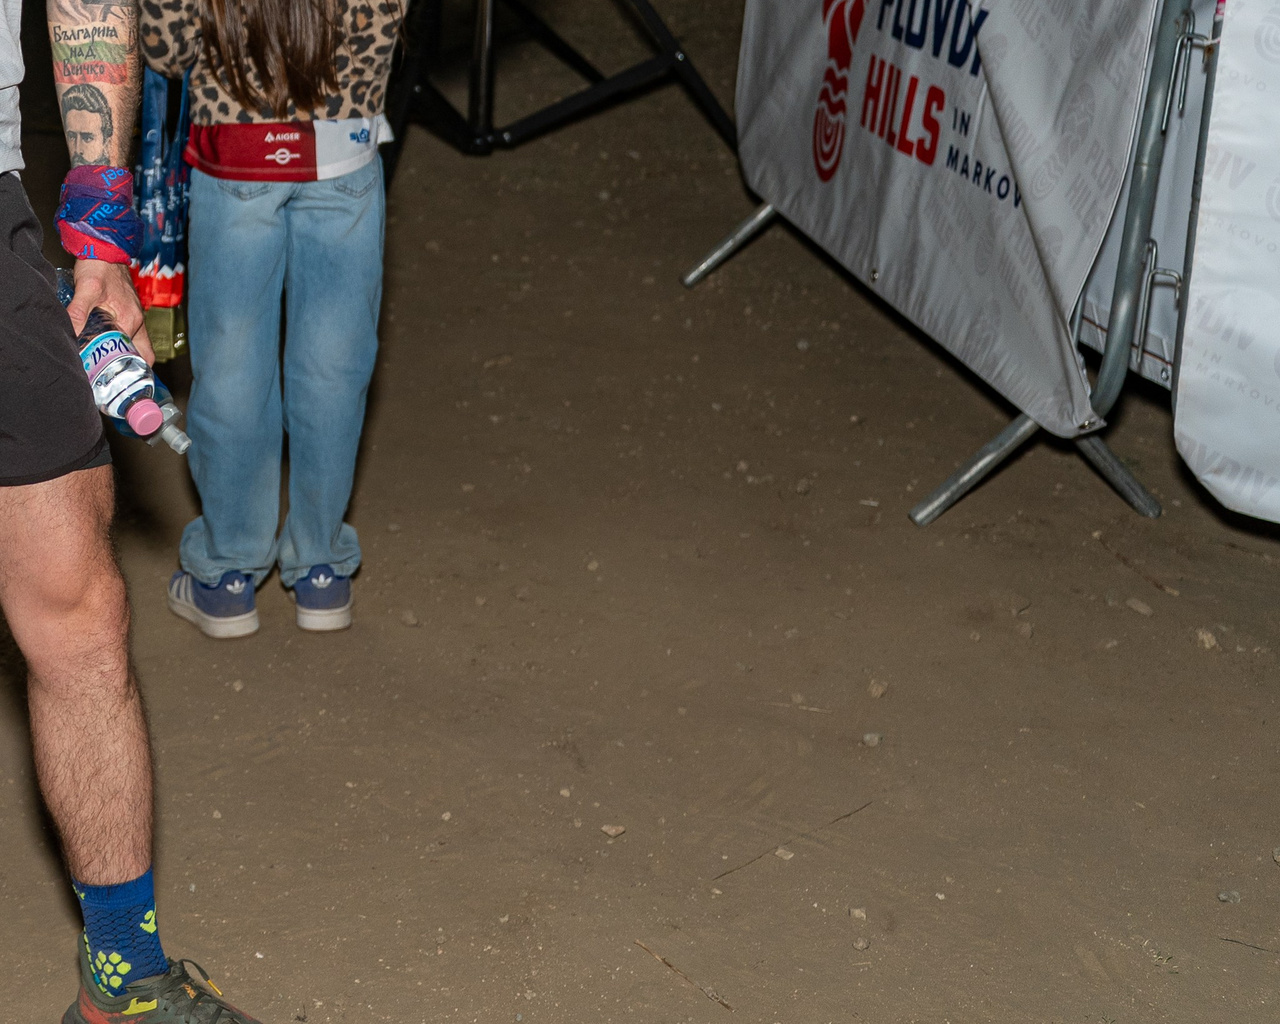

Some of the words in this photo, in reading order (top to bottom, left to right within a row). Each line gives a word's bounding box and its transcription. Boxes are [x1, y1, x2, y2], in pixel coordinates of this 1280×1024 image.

[861, 54, 945, 167] HILLS
[951, 107, 971, 147] IN
[946, 145, 1021, 209] MARKOV
